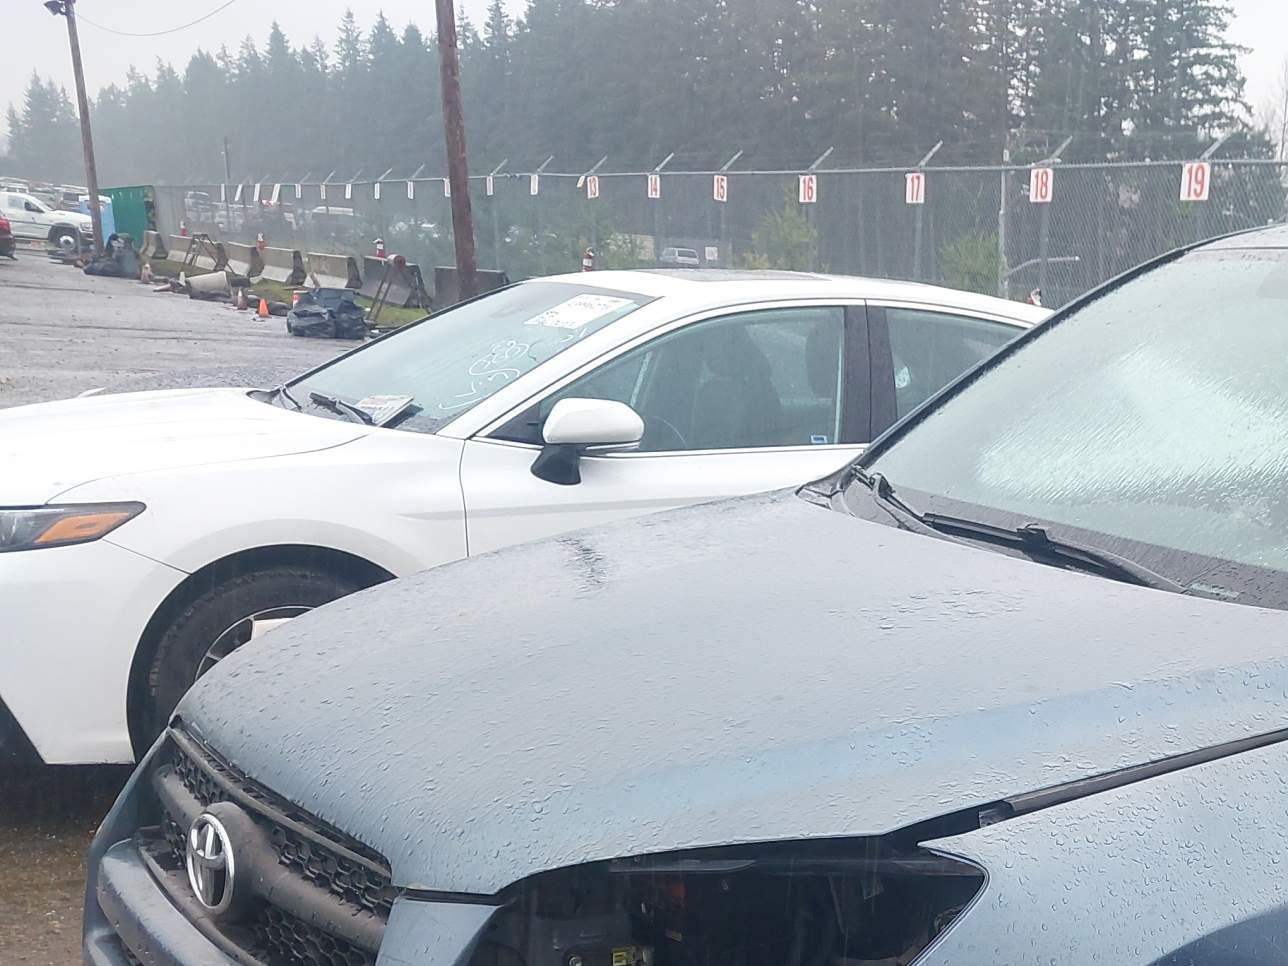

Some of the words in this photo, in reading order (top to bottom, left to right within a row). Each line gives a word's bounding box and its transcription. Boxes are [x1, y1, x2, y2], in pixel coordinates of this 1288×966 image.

[715, 177, 725, 200] 15
[802, 176, 814, 201] 16
[910, 175, 921, 201] 17
[1034, 169, 1049, 200] 18
[1187, 164, 1205, 198] 19
